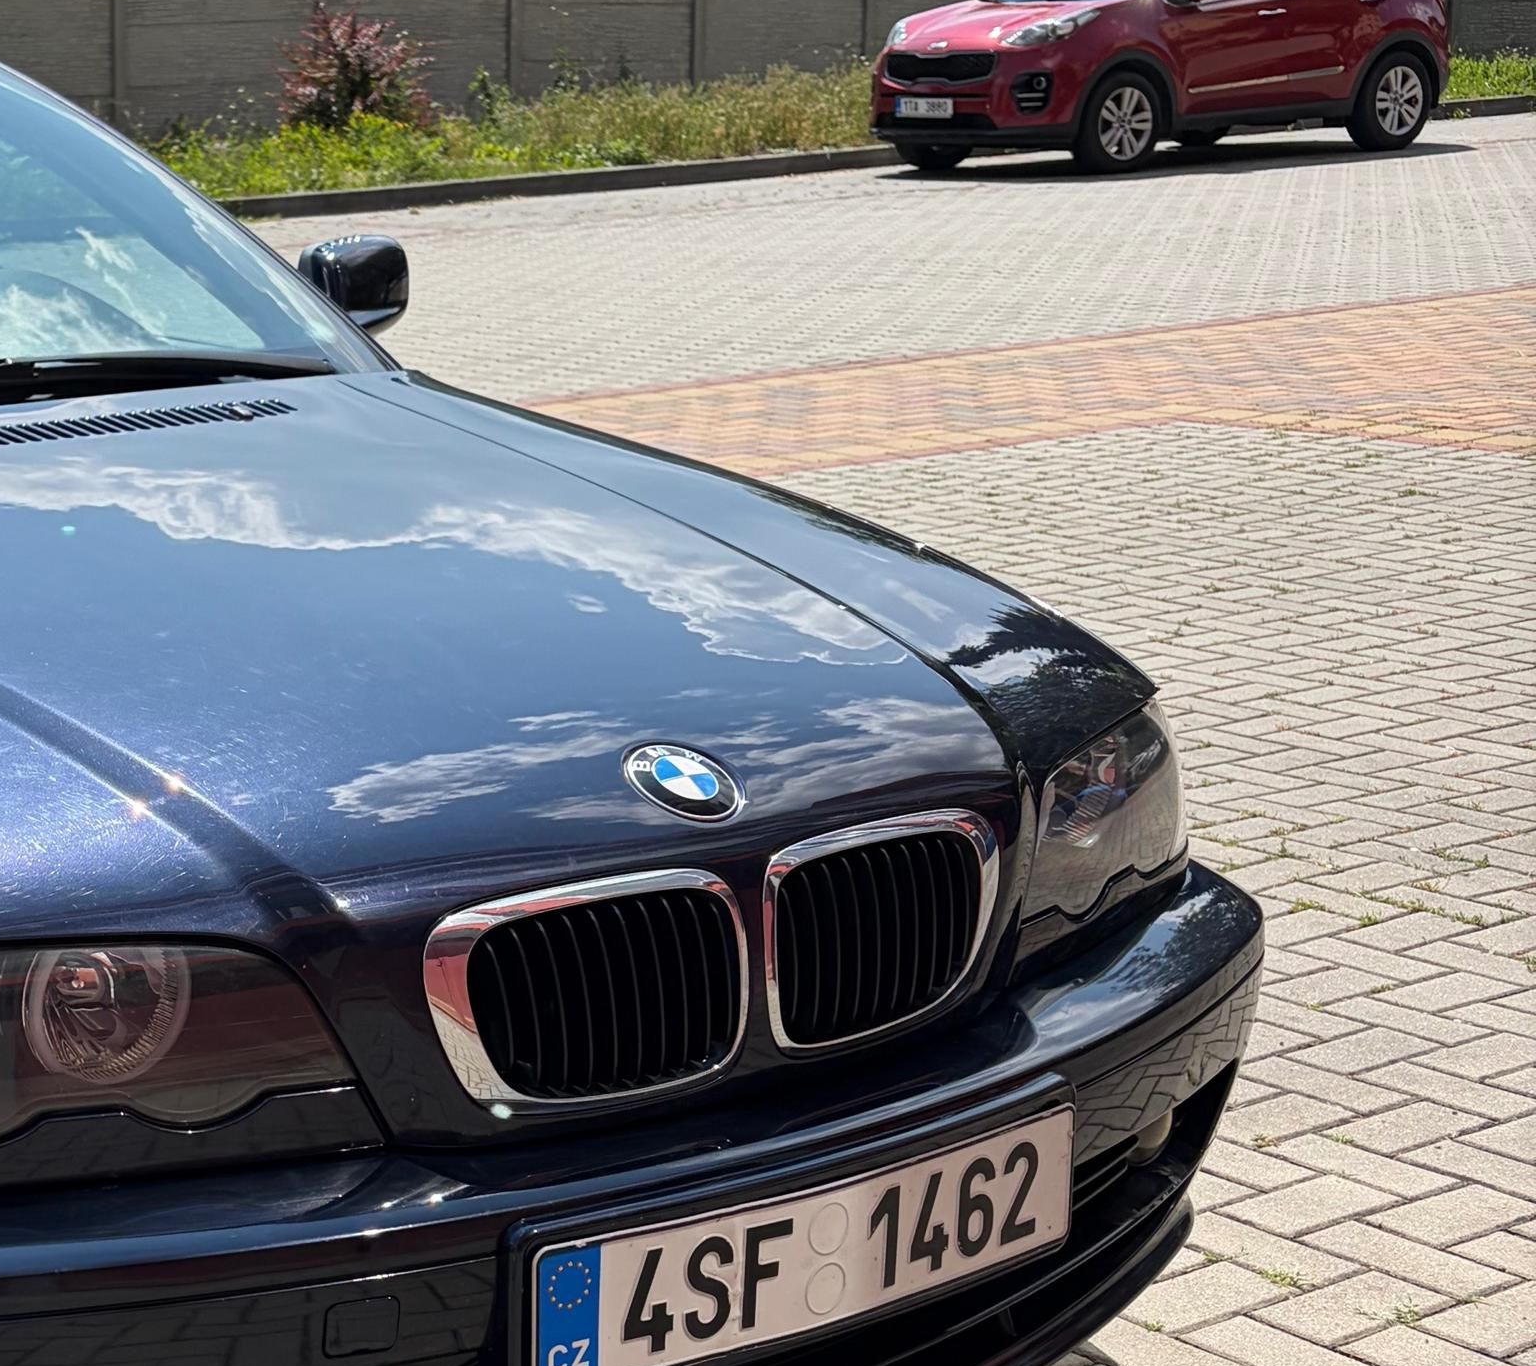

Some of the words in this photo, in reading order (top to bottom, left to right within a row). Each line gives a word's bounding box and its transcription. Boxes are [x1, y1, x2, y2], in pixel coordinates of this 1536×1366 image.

[631, 746, 704, 772] BMW
[623, 1218, 793, 1353] 4SF
[867, 1141, 1039, 1288] 1462
